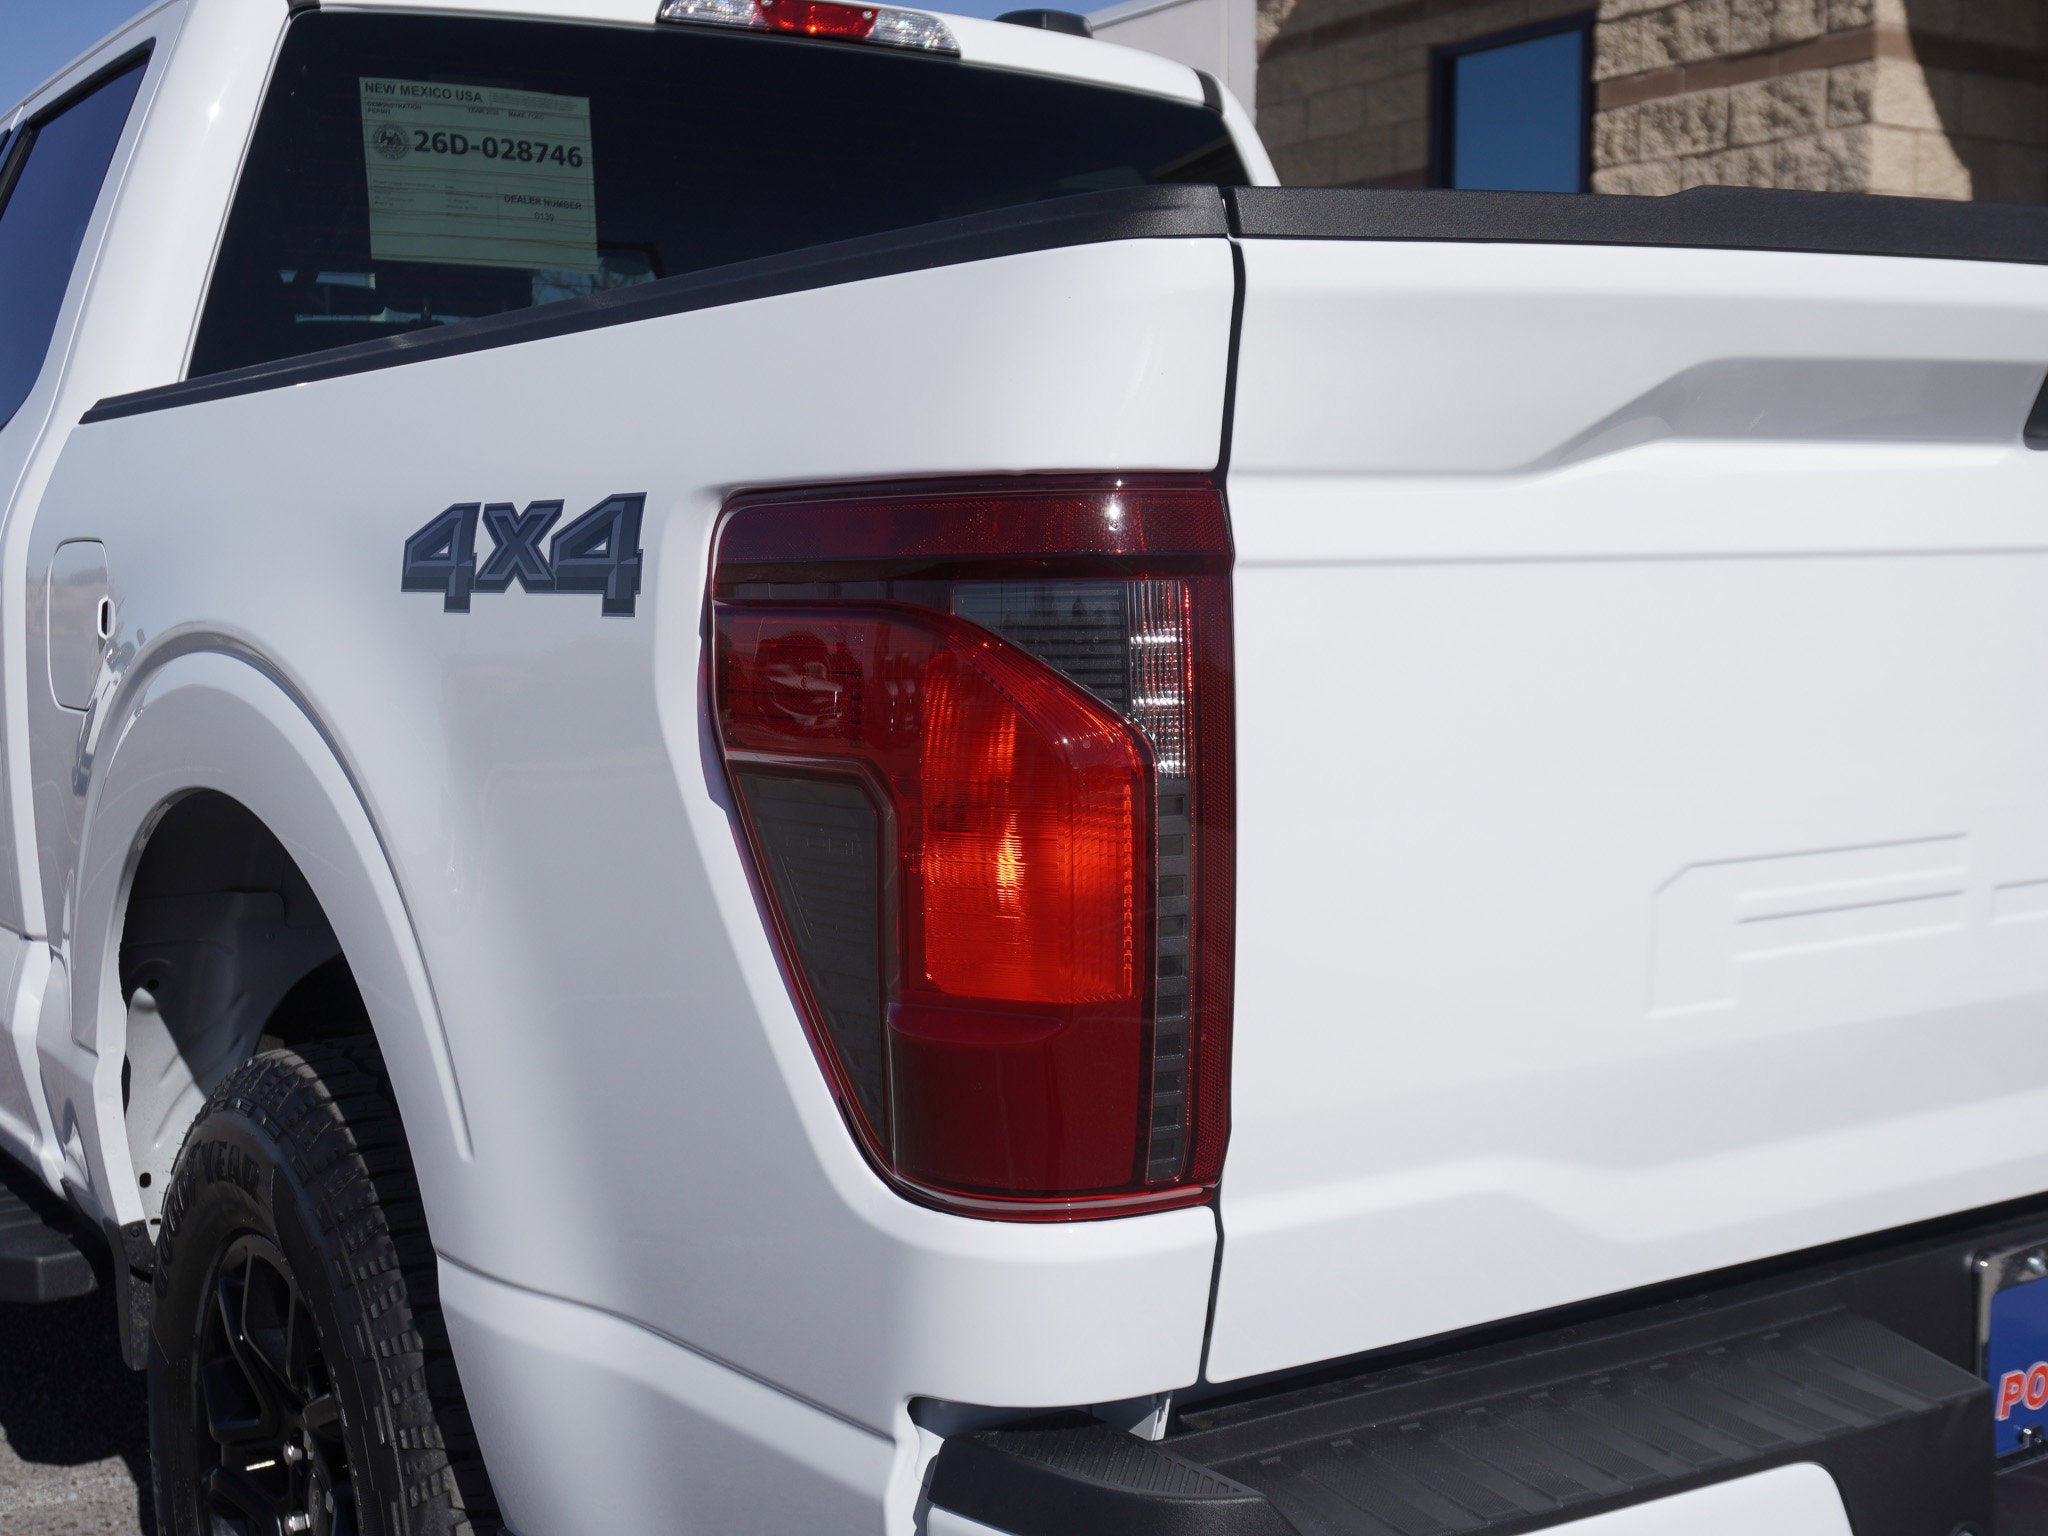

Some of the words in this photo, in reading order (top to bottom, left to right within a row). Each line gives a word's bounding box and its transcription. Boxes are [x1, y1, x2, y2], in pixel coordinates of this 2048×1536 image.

[365, 82, 396, 94] NEW
[400, 85, 452, 99] MEXICO
[456, 90, 483, 102] USA
[413, 130, 583, 168] 26D-028746
[504, 194, 541, 205] DEALER
[543, 198, 583, 210] NUMBER
[400, 492, 648, 617] 4X4
